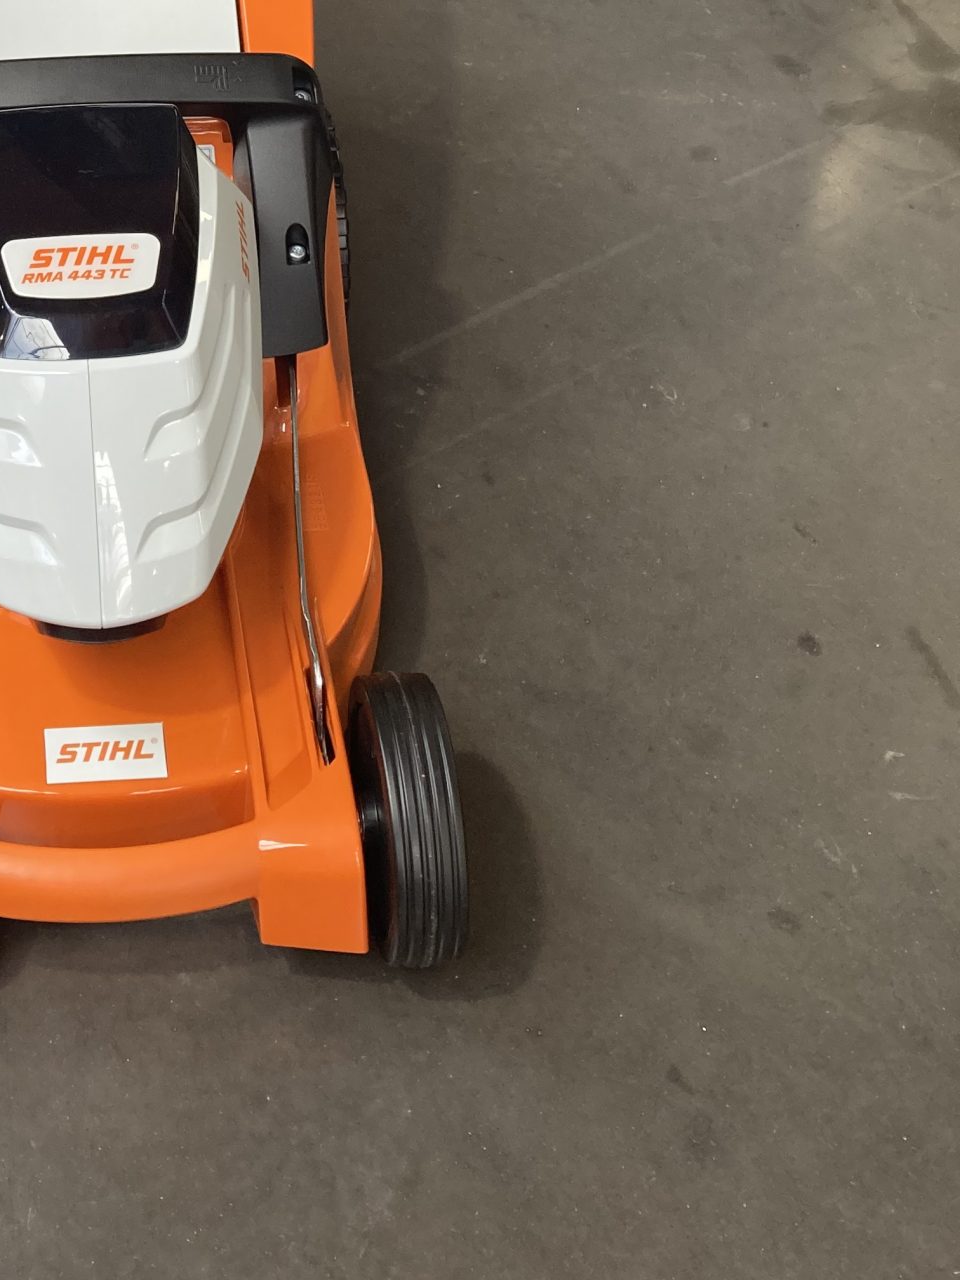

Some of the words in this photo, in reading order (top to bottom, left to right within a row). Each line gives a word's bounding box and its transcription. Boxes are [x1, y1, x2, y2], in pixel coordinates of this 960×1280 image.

[29, 244, 135, 269] STIHL
[21, 271, 63, 285] RMA
[67, 268, 105, 282] 443
[110, 267, 132, 280] TC
[56, 739, 154, 764] STIHL
